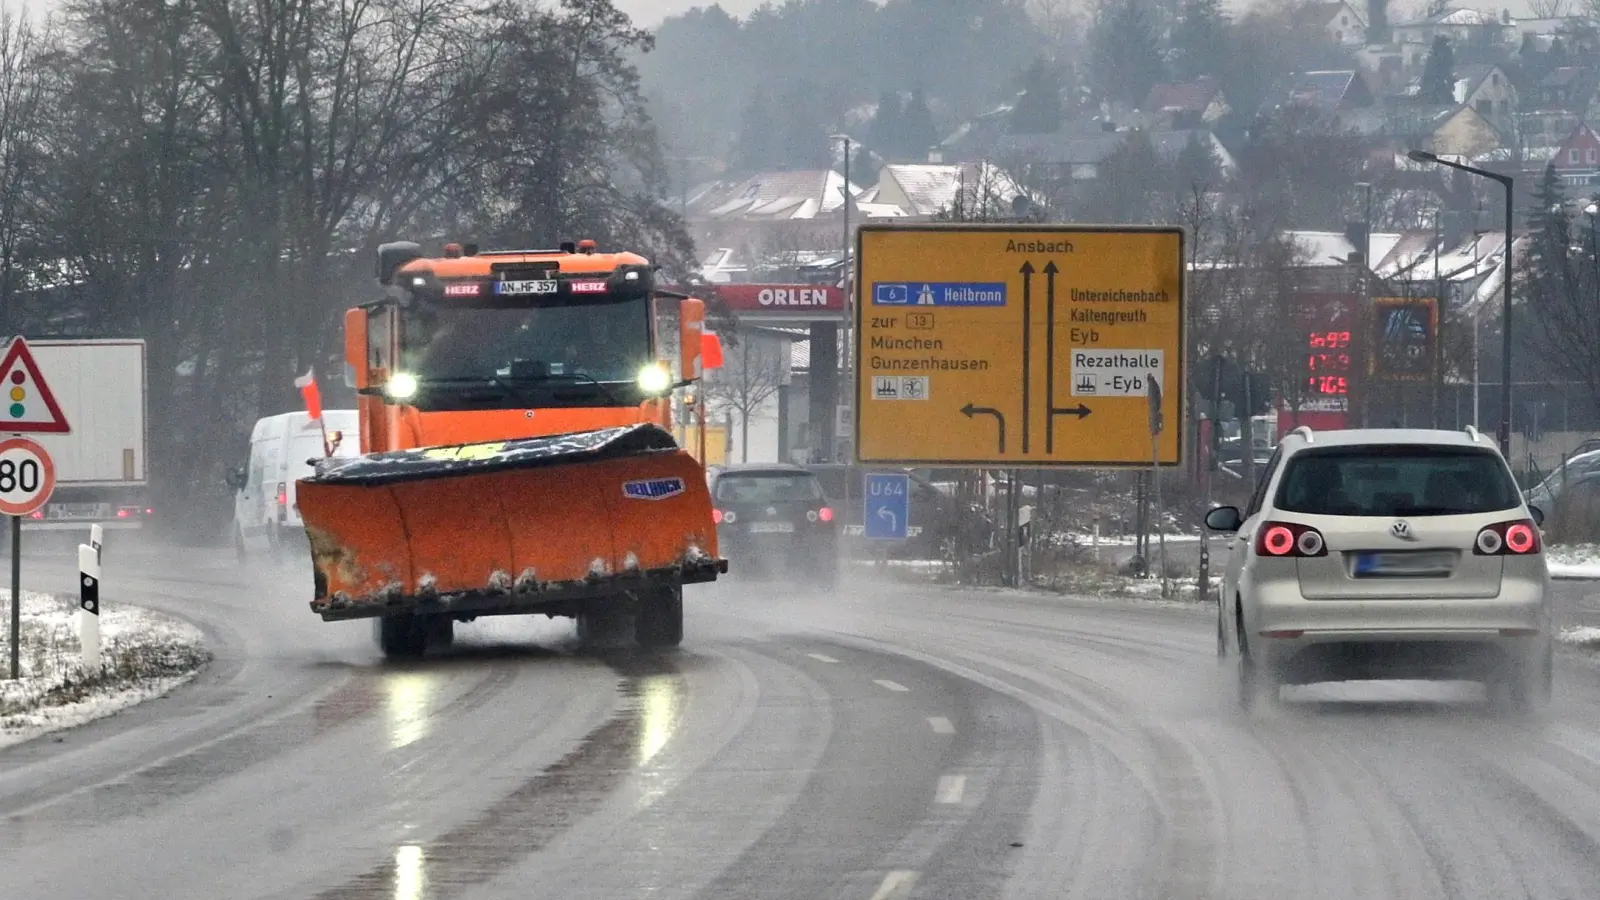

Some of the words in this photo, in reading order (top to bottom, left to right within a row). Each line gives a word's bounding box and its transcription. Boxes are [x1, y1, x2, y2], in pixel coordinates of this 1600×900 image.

[1005, 239, 1074, 253] Ansbach
[445, 284, 480, 295] HERZ
[501, 282, 515, 293] AN
[519, 281, 536, 293] HF
[537, 280, 557, 293] 357
[571, 282, 607, 293] HERZ
[758, 288, 828, 306] ORLEN
[888, 289, 896, 300] 6
[944, 287, 1002, 303] Heilbronn
[1070, 288, 1169, 303] Untereichenbach
[871, 317, 897, 328] zur
[914, 315, 926, 326] 13
[1070, 308, 1147, 326] Kaltengreuth
[871, 336, 943, 350] München
[1070, 327, 1099, 345] Eyb
[871, 356, 989, 371] Gunzenhausen
[1075, 353, 1159, 369] Rezathalle
[1104, 374, 1142, 394] -Eyb
[0, 459, 38, 493] 80
[871, 482, 881, 496] U
[884, 482, 902, 496] 64
